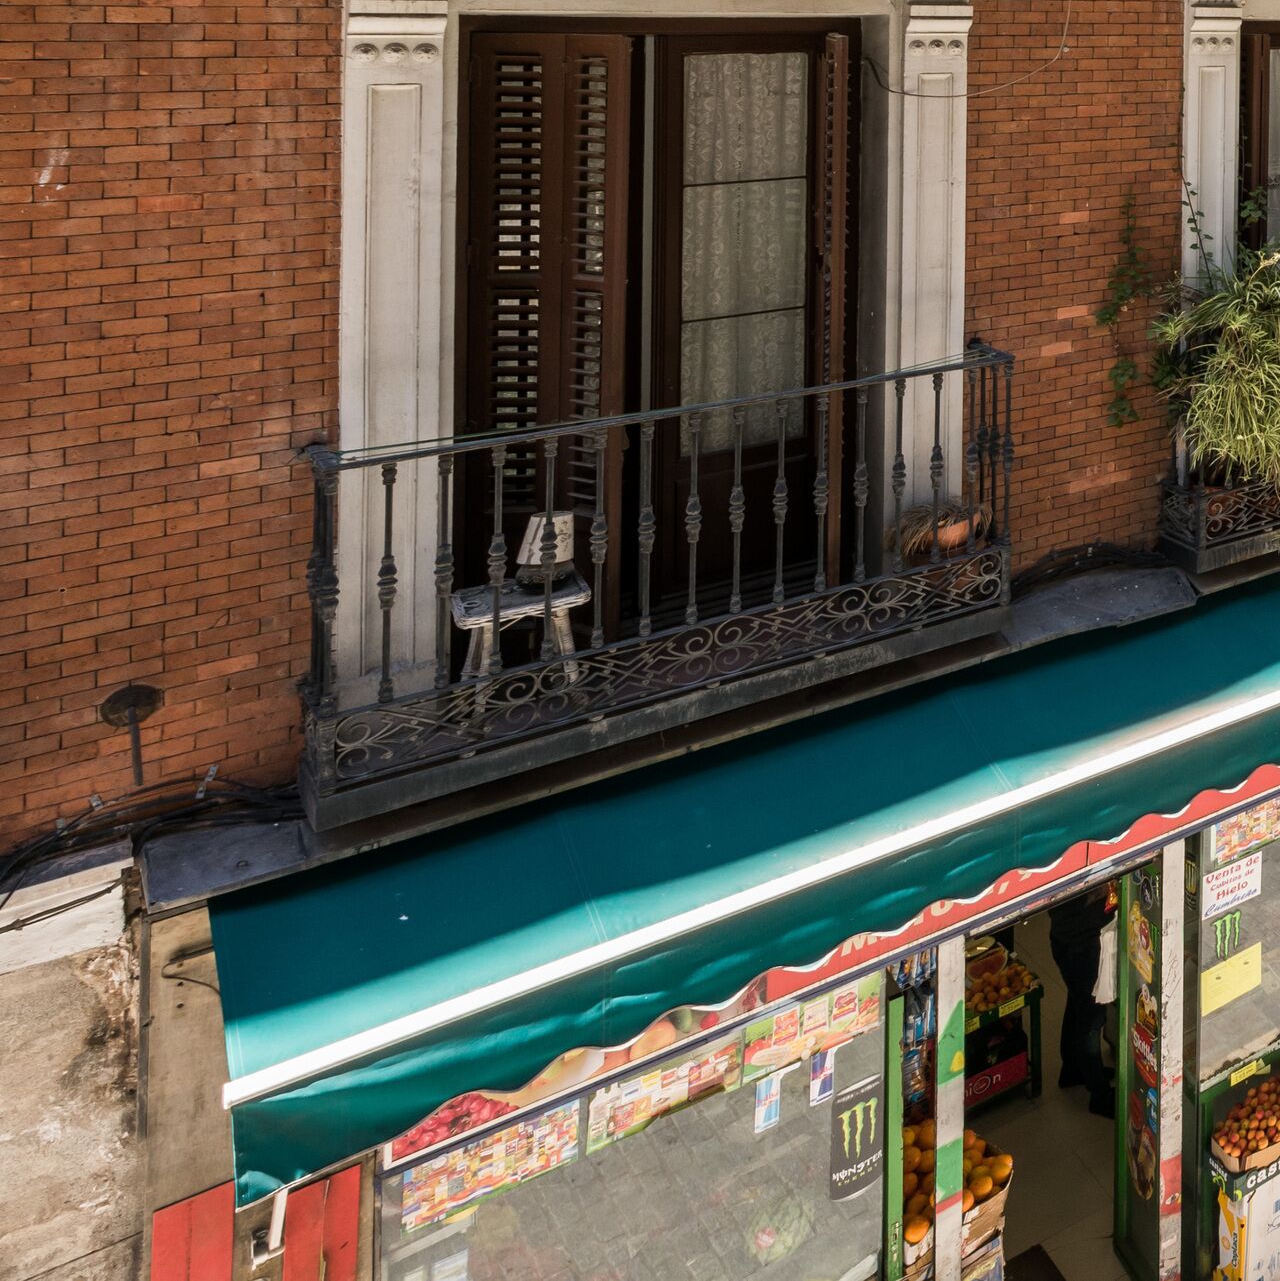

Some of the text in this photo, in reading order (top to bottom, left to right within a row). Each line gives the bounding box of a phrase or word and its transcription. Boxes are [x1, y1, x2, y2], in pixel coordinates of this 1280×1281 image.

[1205, 855, 1260, 884] Venta de
[1215, 880, 1249, 900] Hielo
[832, 1149, 883, 1182] MONSTER
